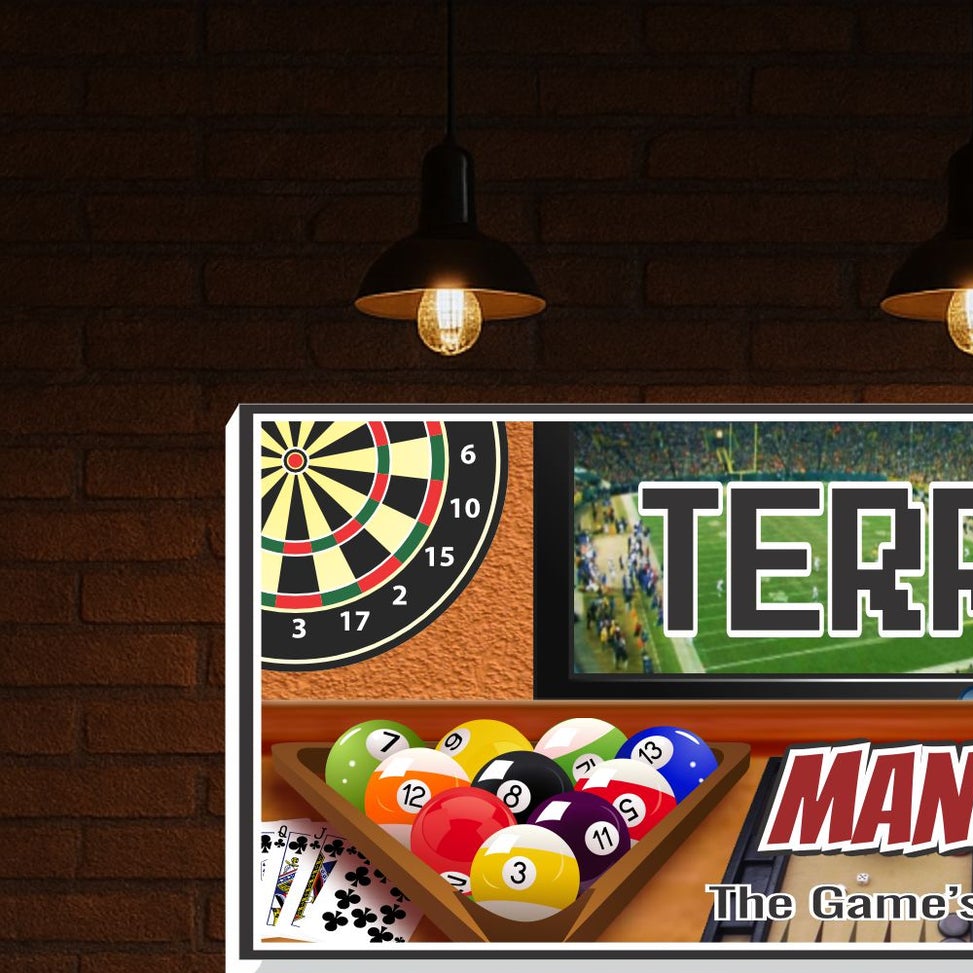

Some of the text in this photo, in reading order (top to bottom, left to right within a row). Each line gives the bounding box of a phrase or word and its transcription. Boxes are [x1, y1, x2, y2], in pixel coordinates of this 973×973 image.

[460, 444, 477, 465] 6
[450, 498, 481, 519] 10
[424, 546, 455, 567] 15
[392, 585, 408, 605] 2
[291, 618, 307, 639] 3
[340, 610, 370, 631] 17
[380, 731, 401, 753] 7
[638, 741, 663, 765] 13
[402, 783, 426, 808] 12
[503, 784, 523, 809] 8
[592, 826, 614, 850] 11
[510, 861, 527, 884] 3
[705, 884, 793, 921] The
